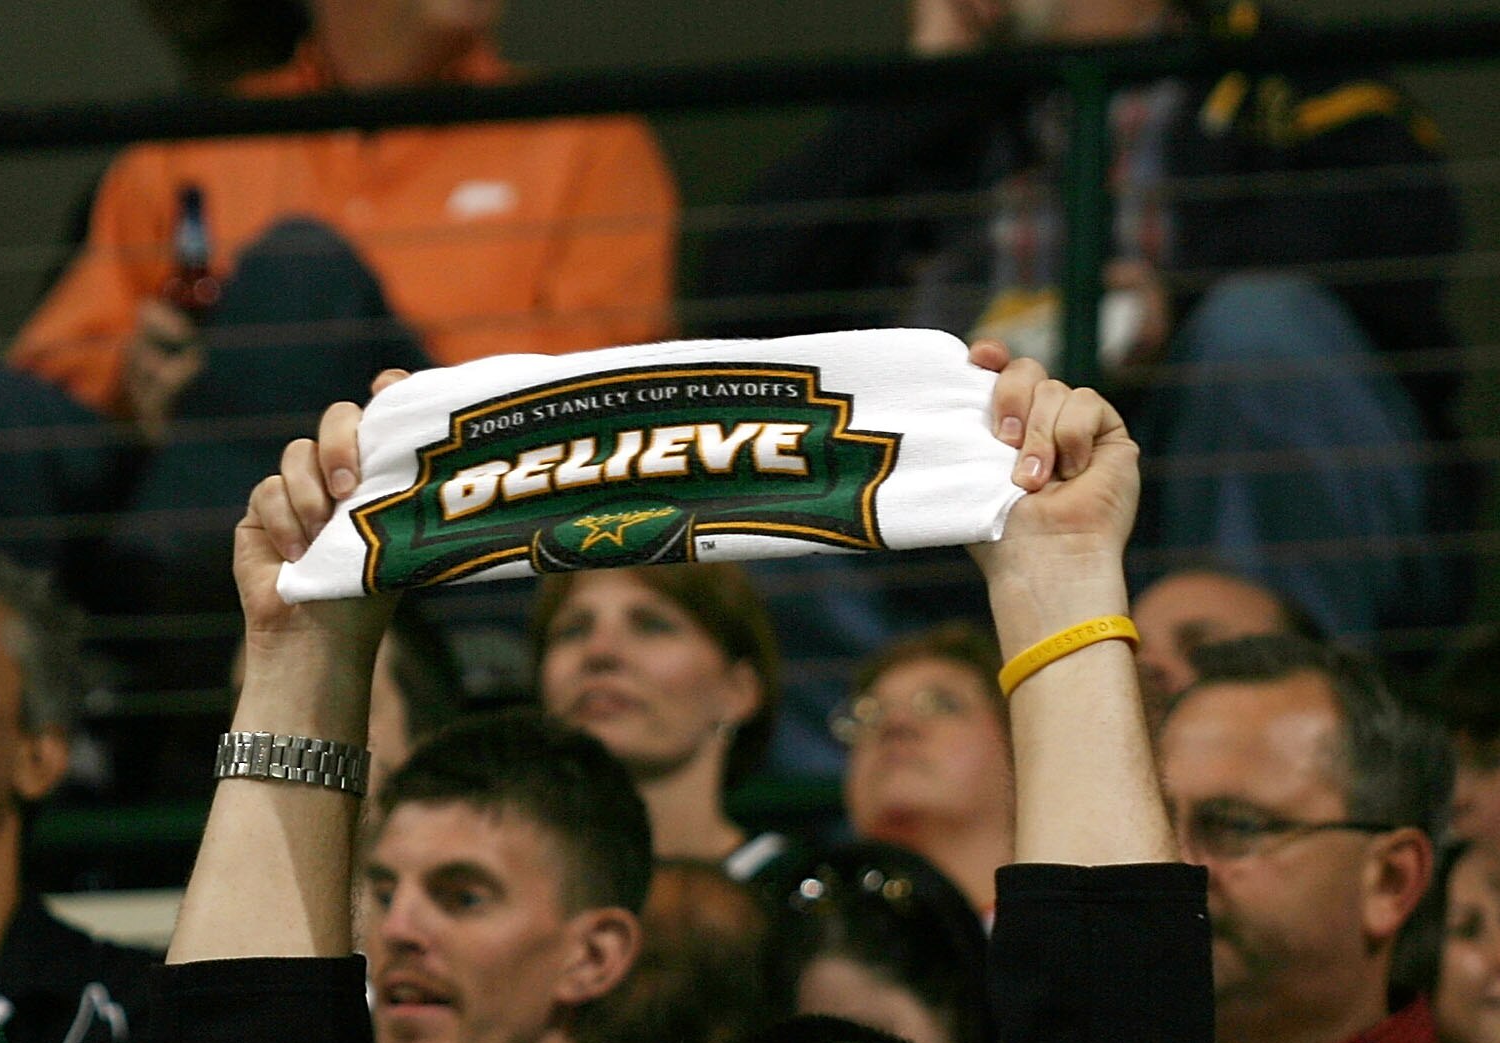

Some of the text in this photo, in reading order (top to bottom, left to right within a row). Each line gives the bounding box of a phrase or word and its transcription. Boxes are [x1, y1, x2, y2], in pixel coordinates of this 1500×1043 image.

[469, 382, 799, 439] 2008 STANLEY CUP PLAYOFFS
[438, 421, 811, 521] BELIEVE
